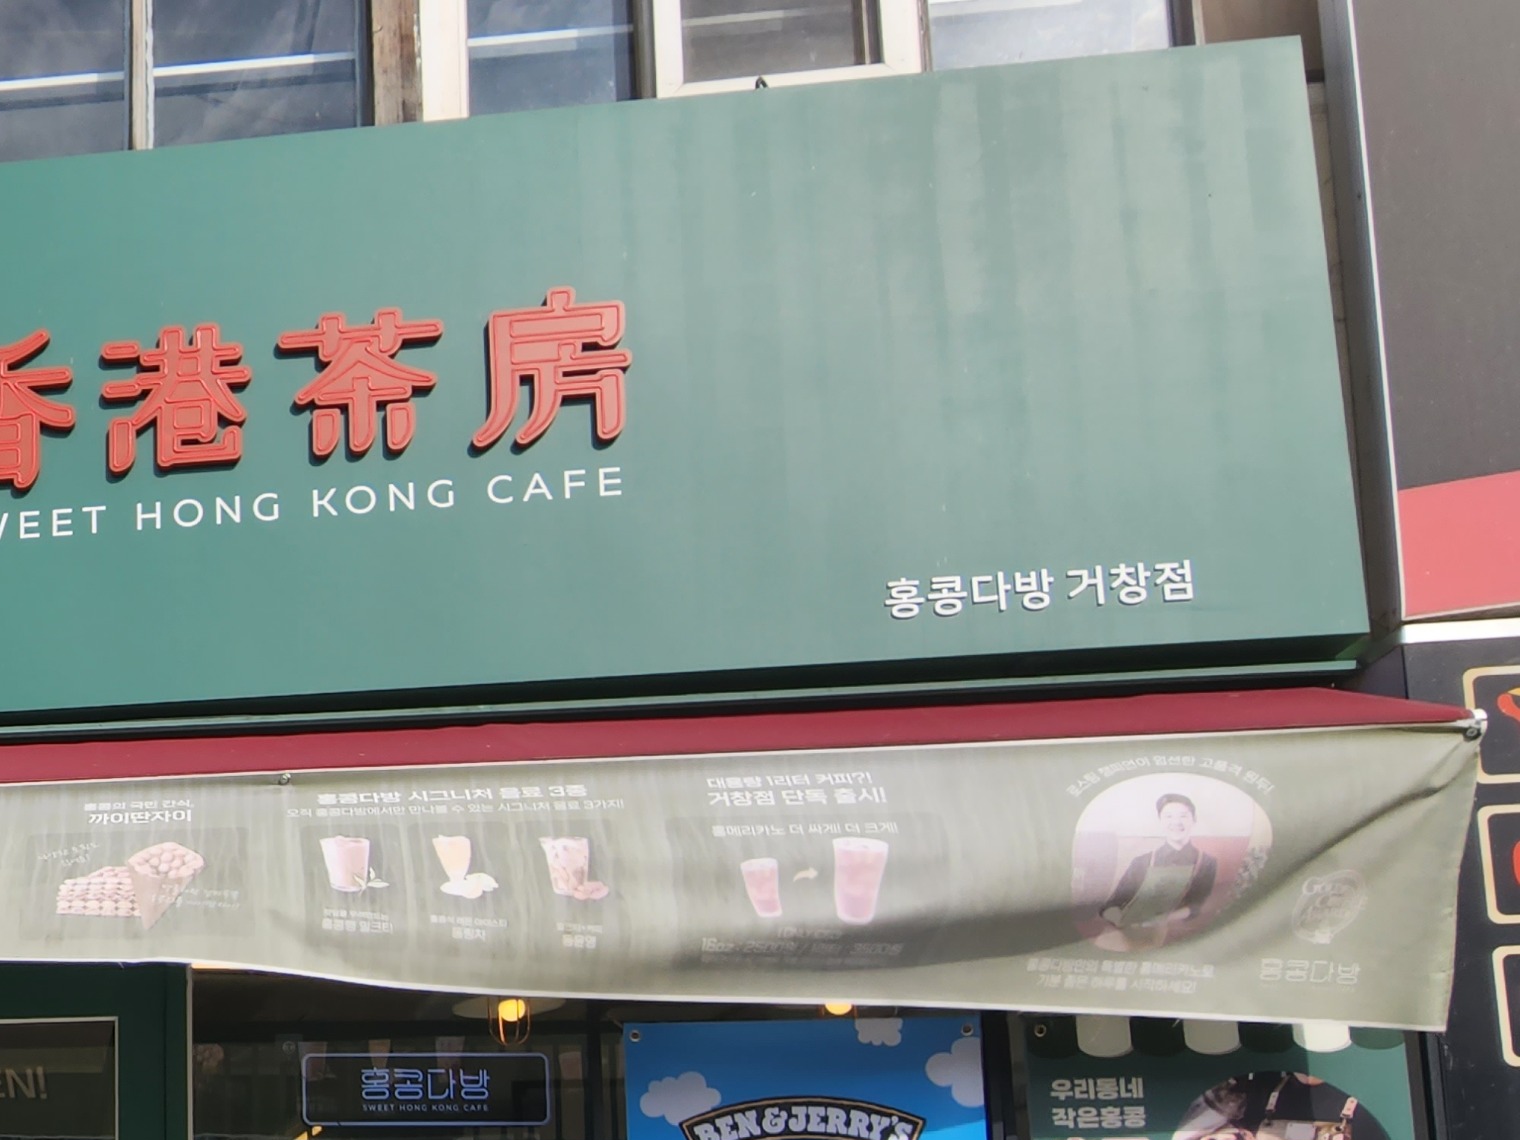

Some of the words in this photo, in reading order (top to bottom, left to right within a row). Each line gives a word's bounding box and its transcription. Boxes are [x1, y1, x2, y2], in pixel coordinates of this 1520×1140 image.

[136, 493, 279, 530] HONG
[312, 479, 455, 518] KONG
[487, 467, 622, 505] CAFE
[884, 568, 1054, 619] 홍콩다방
[1066, 559, 1194, 605] 거창점
[706, 776, 762, 789] 대용량
[768, 774, 810, 786] 1리터
[816, 771, 873, 785] 커피?!
[316, 792, 401, 805] 홍콩다방
[409, 788, 492, 801] 시그니처
[707, 790, 776, 807] 거창점
[781, 788, 828, 805] 단독
[833, 786, 888, 804] 출시!
[88, 809, 192, 824] 까이딴자이
[451, 803, 464, 813] 수
[466, 802, 495, 813] 있는
[789, 823, 804, 835] 더
[844, 822, 861, 834] 더
[1259, 957, 1361, 985] 홍콩다방
[360, 1066, 490, 1101] 홍콩다방
[1050, 1077, 1144, 1101] 우리동네
[362, 1103, 395, 1112] SWEET
[399, 1103, 428, 1112] HONG
[431, 1103, 460, 1112] KONG
[463, 1103, 489, 1112] CAFE
[1052, 1106, 1147, 1130] 작은홍콩
